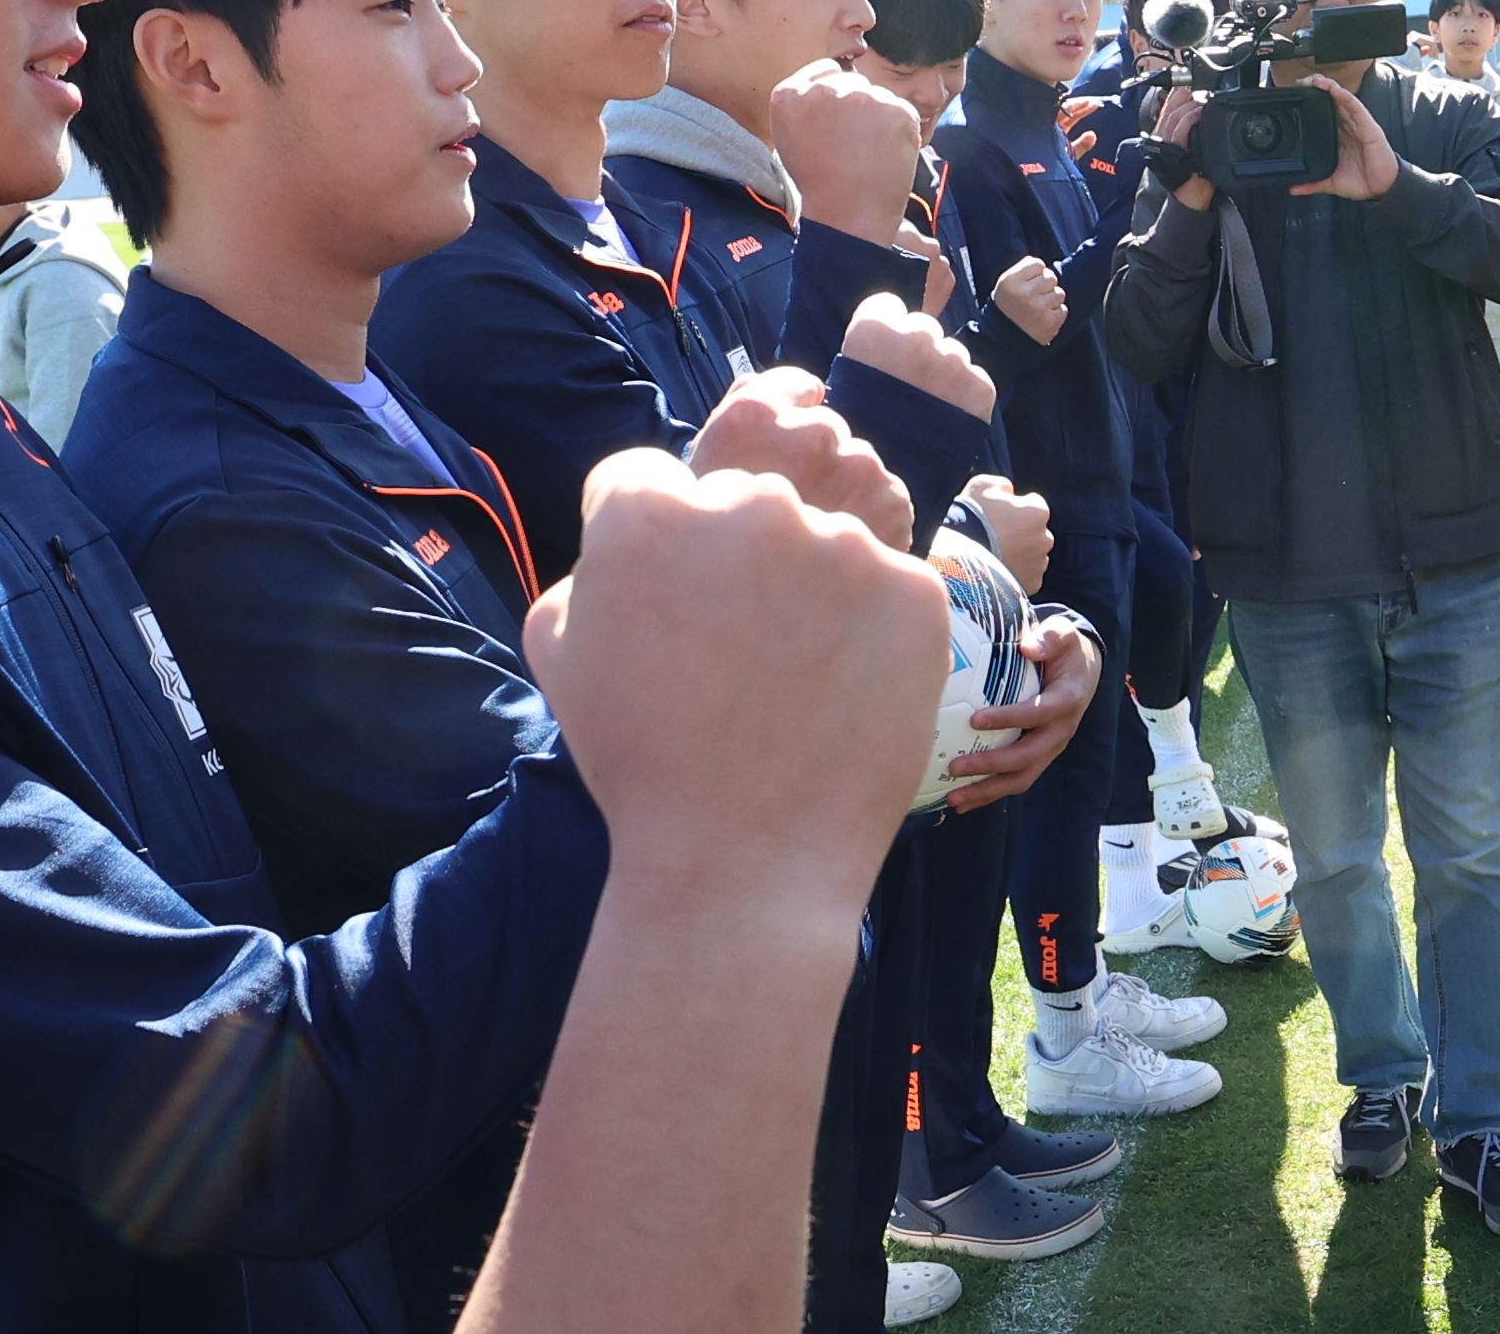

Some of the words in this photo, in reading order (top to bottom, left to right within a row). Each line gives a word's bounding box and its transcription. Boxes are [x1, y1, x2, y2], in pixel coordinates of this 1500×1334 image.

[412, 528, 452, 566] oma
[1039, 935, 1059, 986] Jom
[906, 1071, 921, 1132] oma
